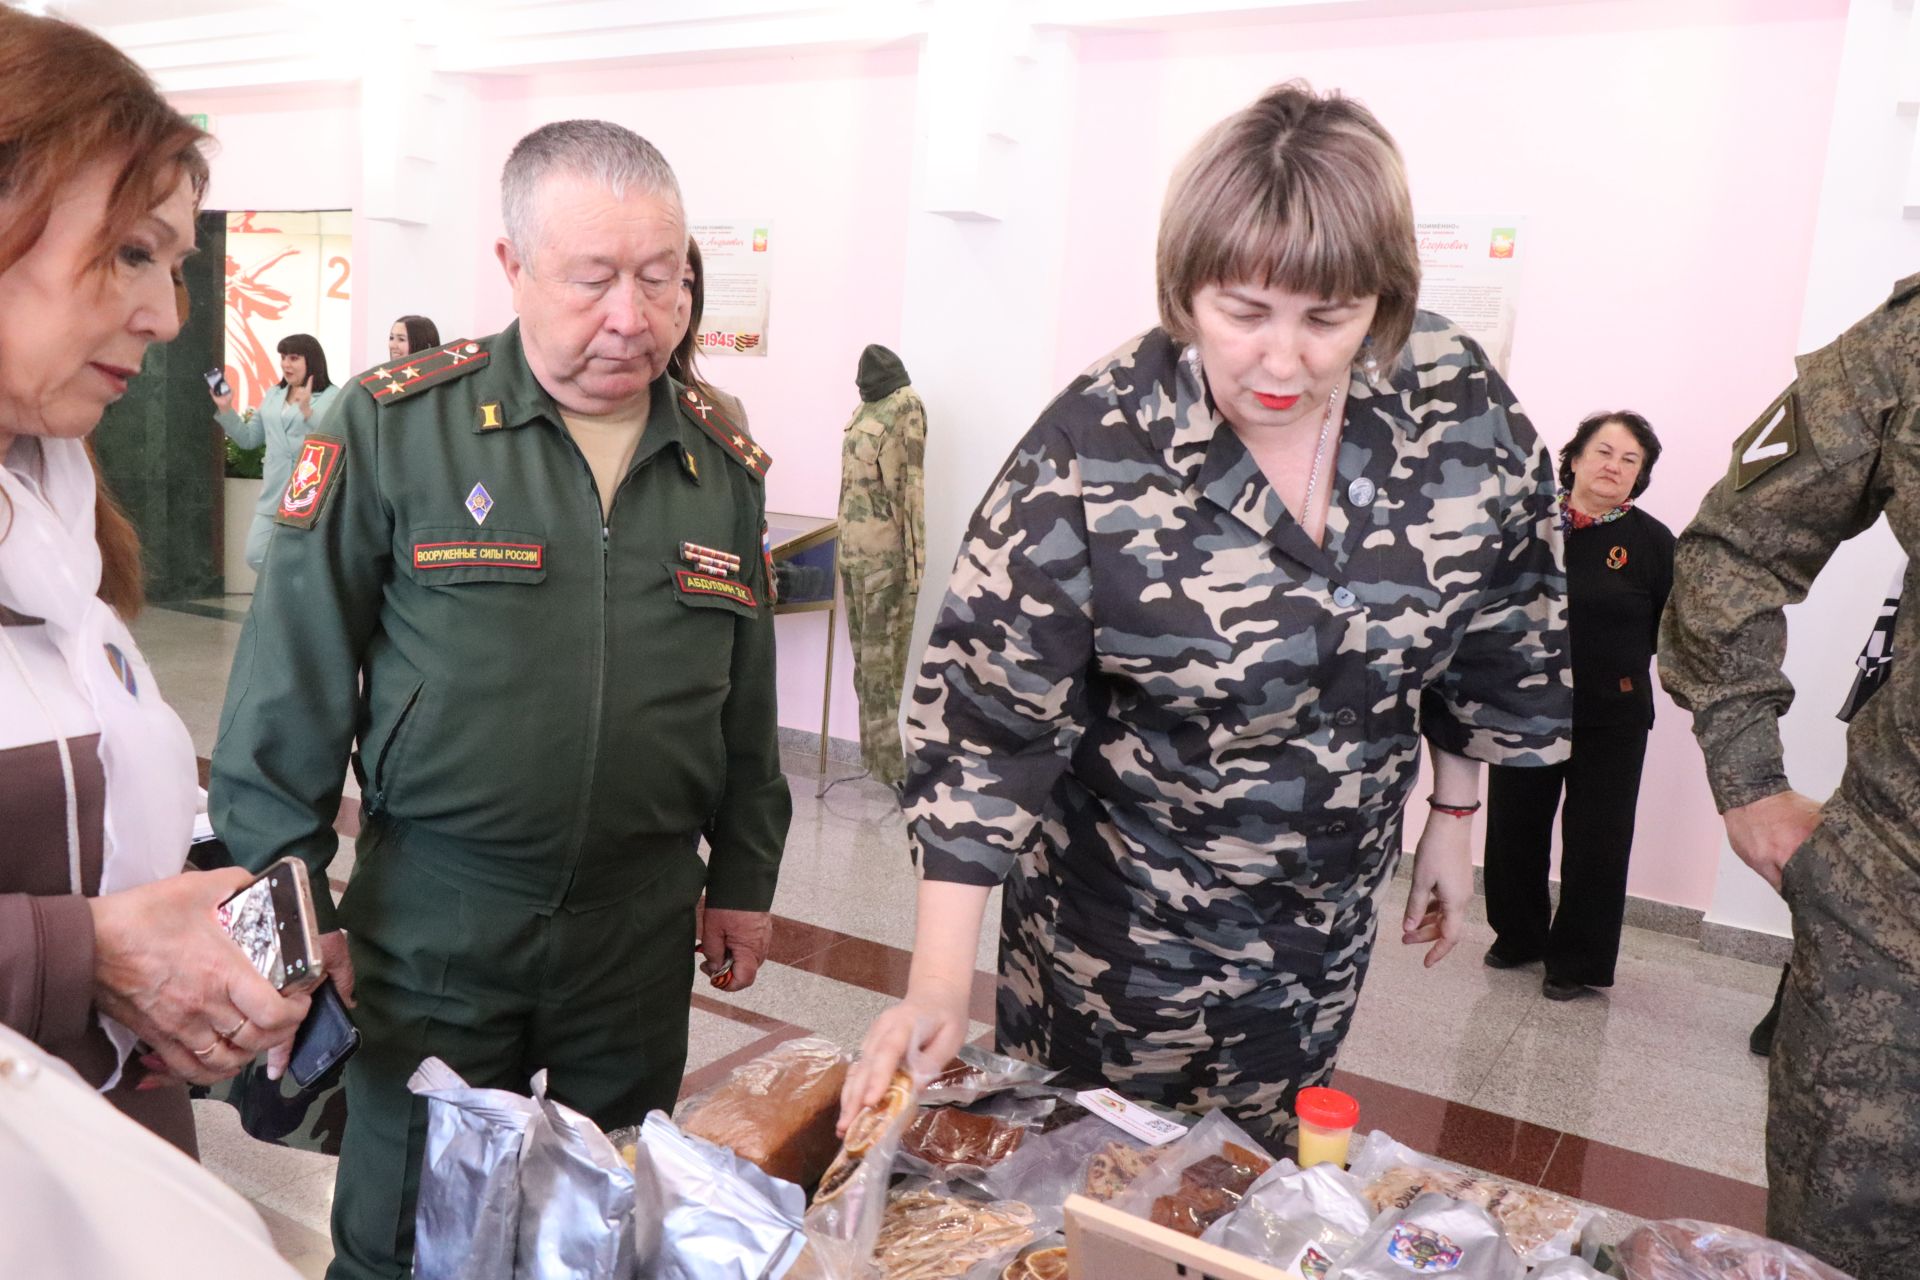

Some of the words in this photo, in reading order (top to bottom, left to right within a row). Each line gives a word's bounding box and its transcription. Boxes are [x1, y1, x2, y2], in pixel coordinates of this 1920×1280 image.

[327, 256, 351, 300] 2
[704, 332, 736, 348] 1945
[417, 548, 477, 562] ВООРУЖЕННЫЕ
[480, 548, 503, 559] СИЛЫ
[505, 549, 538, 561] РОССИИ
